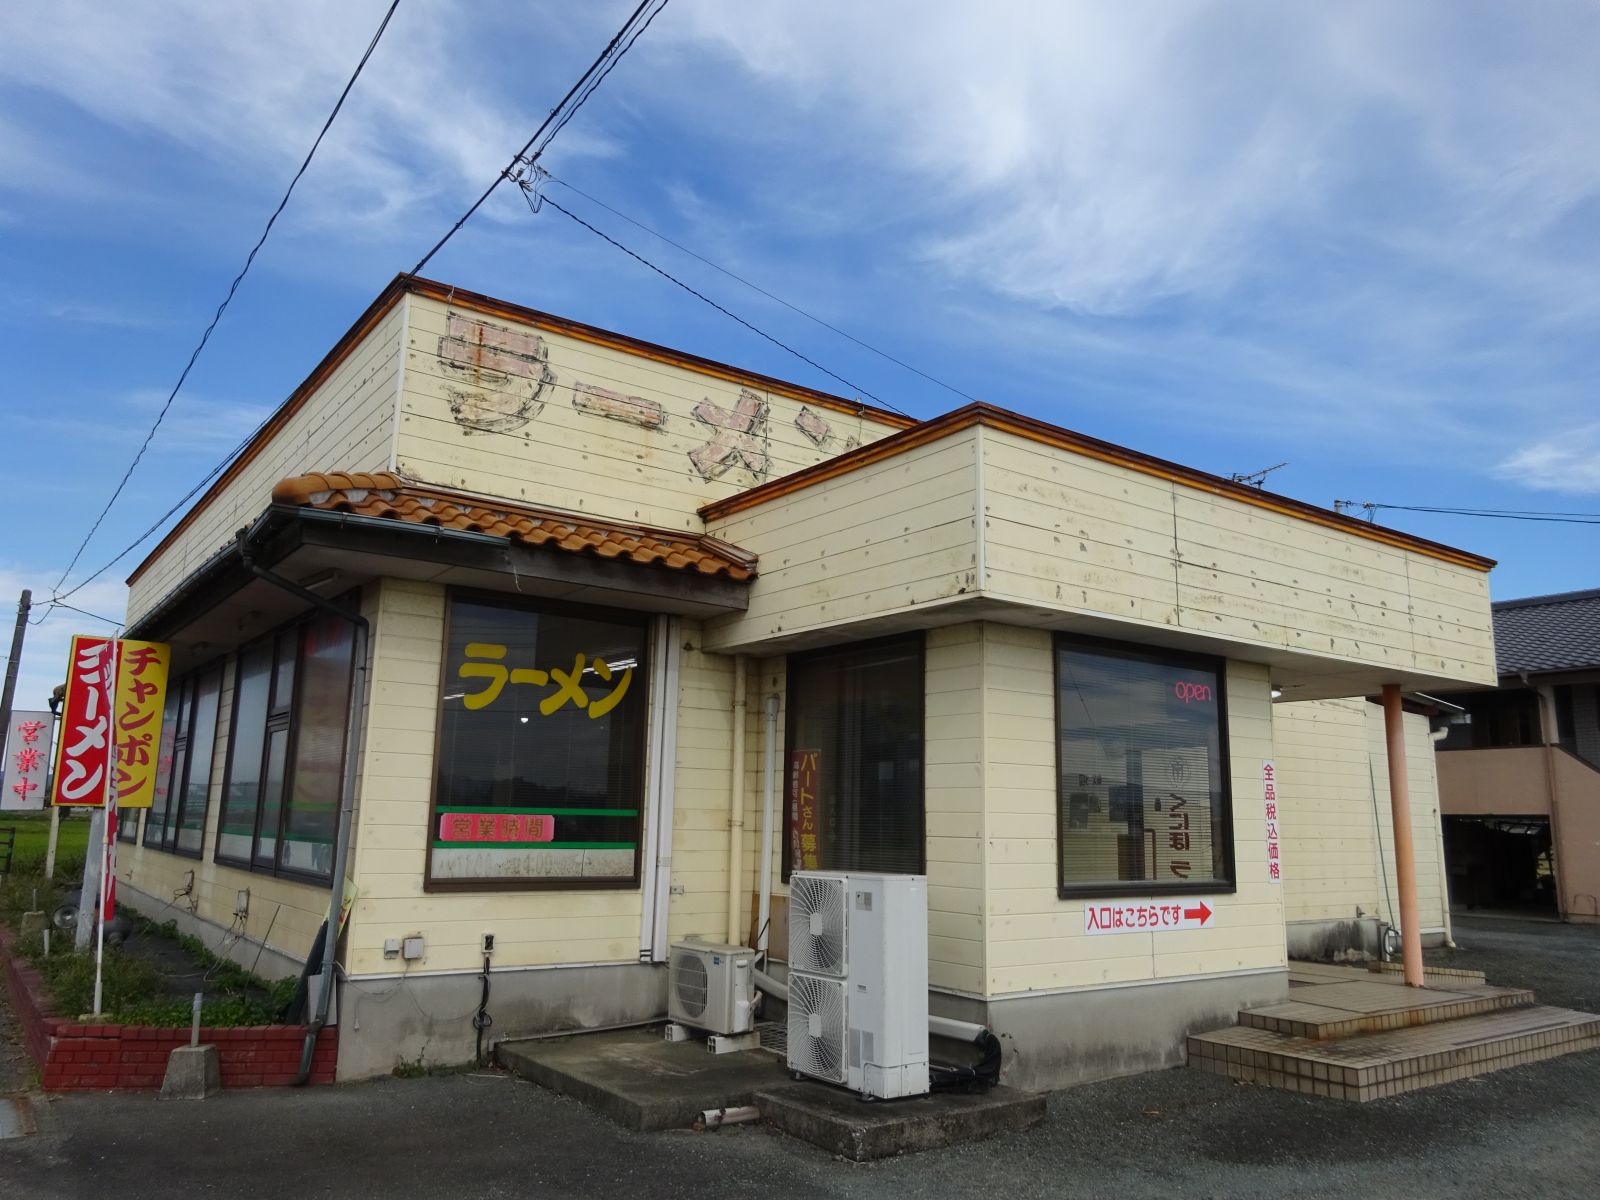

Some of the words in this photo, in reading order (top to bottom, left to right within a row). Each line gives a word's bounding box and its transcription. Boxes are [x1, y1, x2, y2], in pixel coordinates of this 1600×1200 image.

[437, 310, 862, 484] ラーメ
[61, 640, 108, 800] ラーメン
[117, 647, 162, 798] チャンポン
[458, 643, 633, 719] ラーメン
[1175, 680, 1212, 703] open
[12, 720, 47, 801] 営業中
[452, 818, 544, 837] 営業時間
[800, 752, 818, 870] パートさん募集
[1263, 764, 1280, 880] 全品税込価格
[1087, 904, 1182, 931] 入口はこちらです
